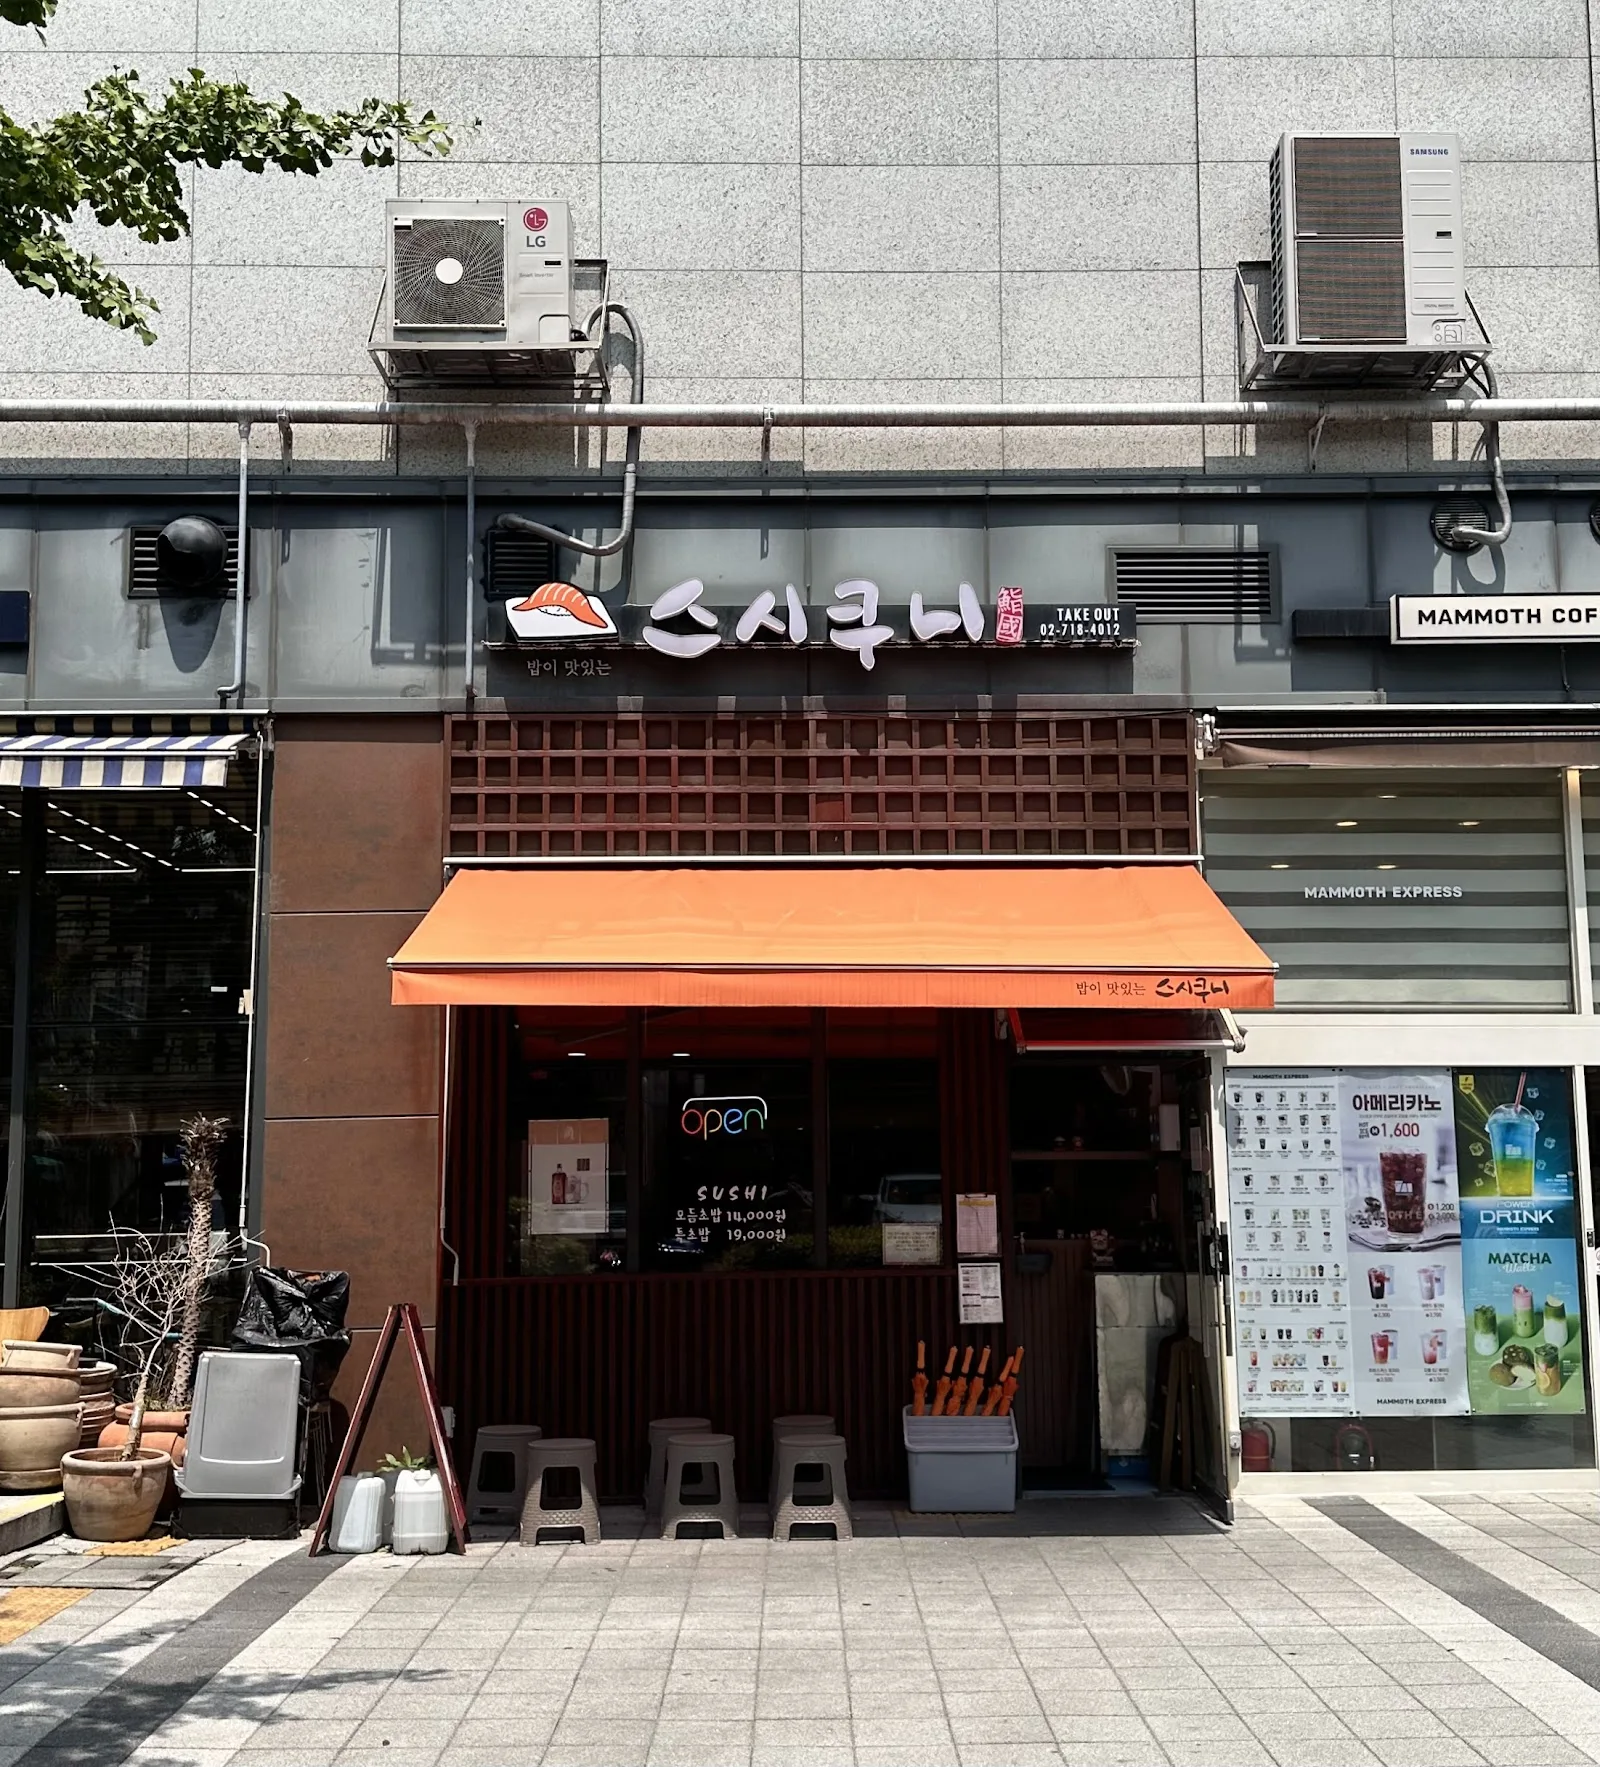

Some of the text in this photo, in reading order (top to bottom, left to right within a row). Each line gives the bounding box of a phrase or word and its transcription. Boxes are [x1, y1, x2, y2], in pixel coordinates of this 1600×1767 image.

[1409, 148, 1449, 156] SAMSUNG
[526, 235, 546, 248] LG
[1057, 608, 1120, 621] TAKE OUT
[1418, 607, 1598, 625] MAMMOTH COF
[642, 577, 985, 671] 스시쿠니
[1040, 624, 1120, 636] 02-718-4012
[527, 659, 612, 676] 밥이 맛있는
[1304, 886, 1463, 898] MAMMOTH EXPRESS
[1076, 977, 1230, 1003] 밥이 맛있는 스시쿠니
[1352, 1094, 1441, 1111] 아메리카노
[681, 1108, 764, 1140] open
[1381, 1122, 1420, 1138] 1,600
[697, 1185, 768, 1201] SUSHI
[675, 1207, 786, 1223] 모듬초밥 14,000원
[1480, 1209, 1554, 1223] DRINK
[675, 1227, 786, 1243] 특초밥 19,000원
[1488, 1252, 1552, 1264] MATCHA
